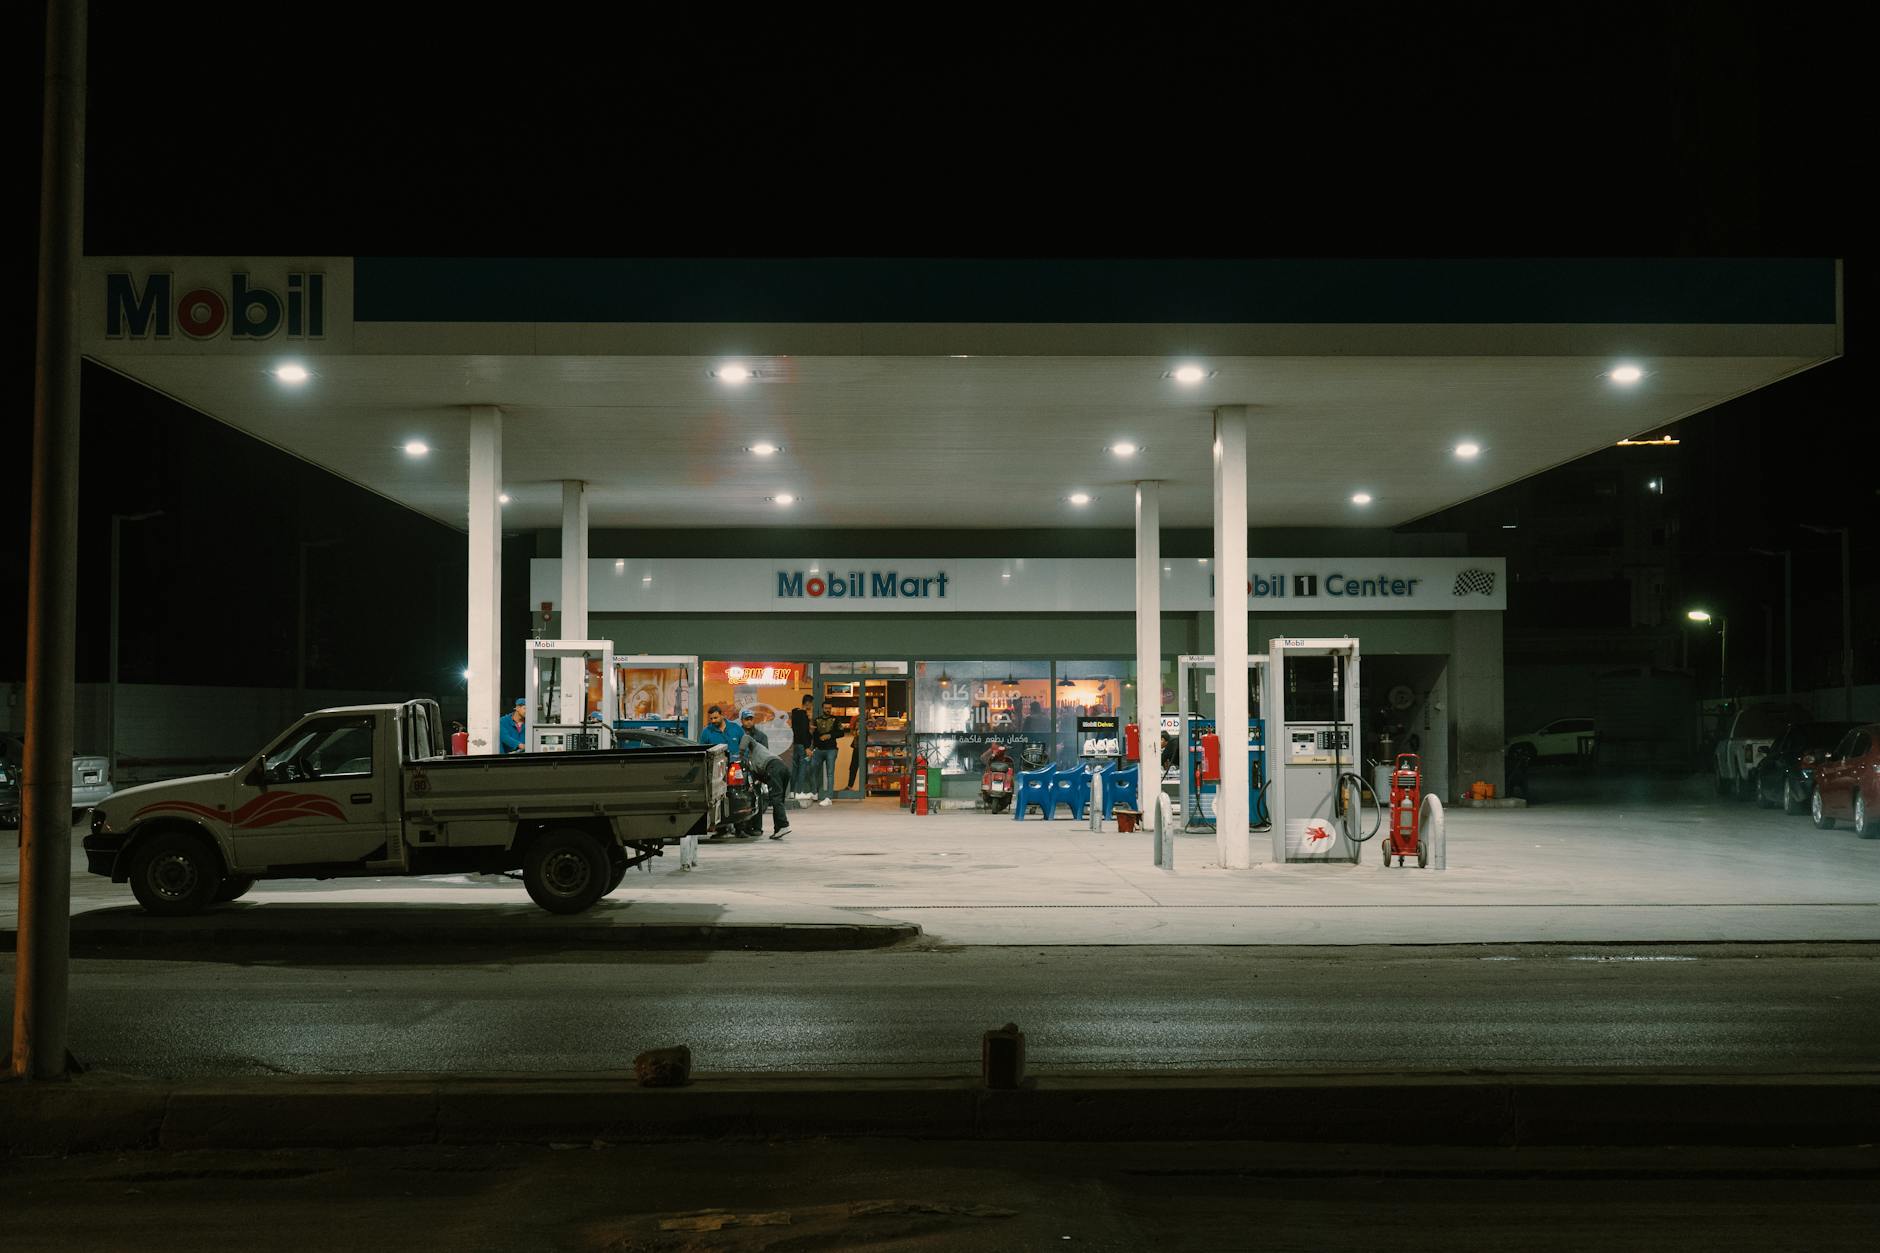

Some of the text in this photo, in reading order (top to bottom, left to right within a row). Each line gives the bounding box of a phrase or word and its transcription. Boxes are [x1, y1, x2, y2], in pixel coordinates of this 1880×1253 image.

[105, 272, 327, 340] Mobil
[777, 572, 949, 597] Mobil Mart
[1210, 575, 1285, 597] bil
[1325, 574, 1419, 597] Center
[1160, 719, 1180, 727] Mob
